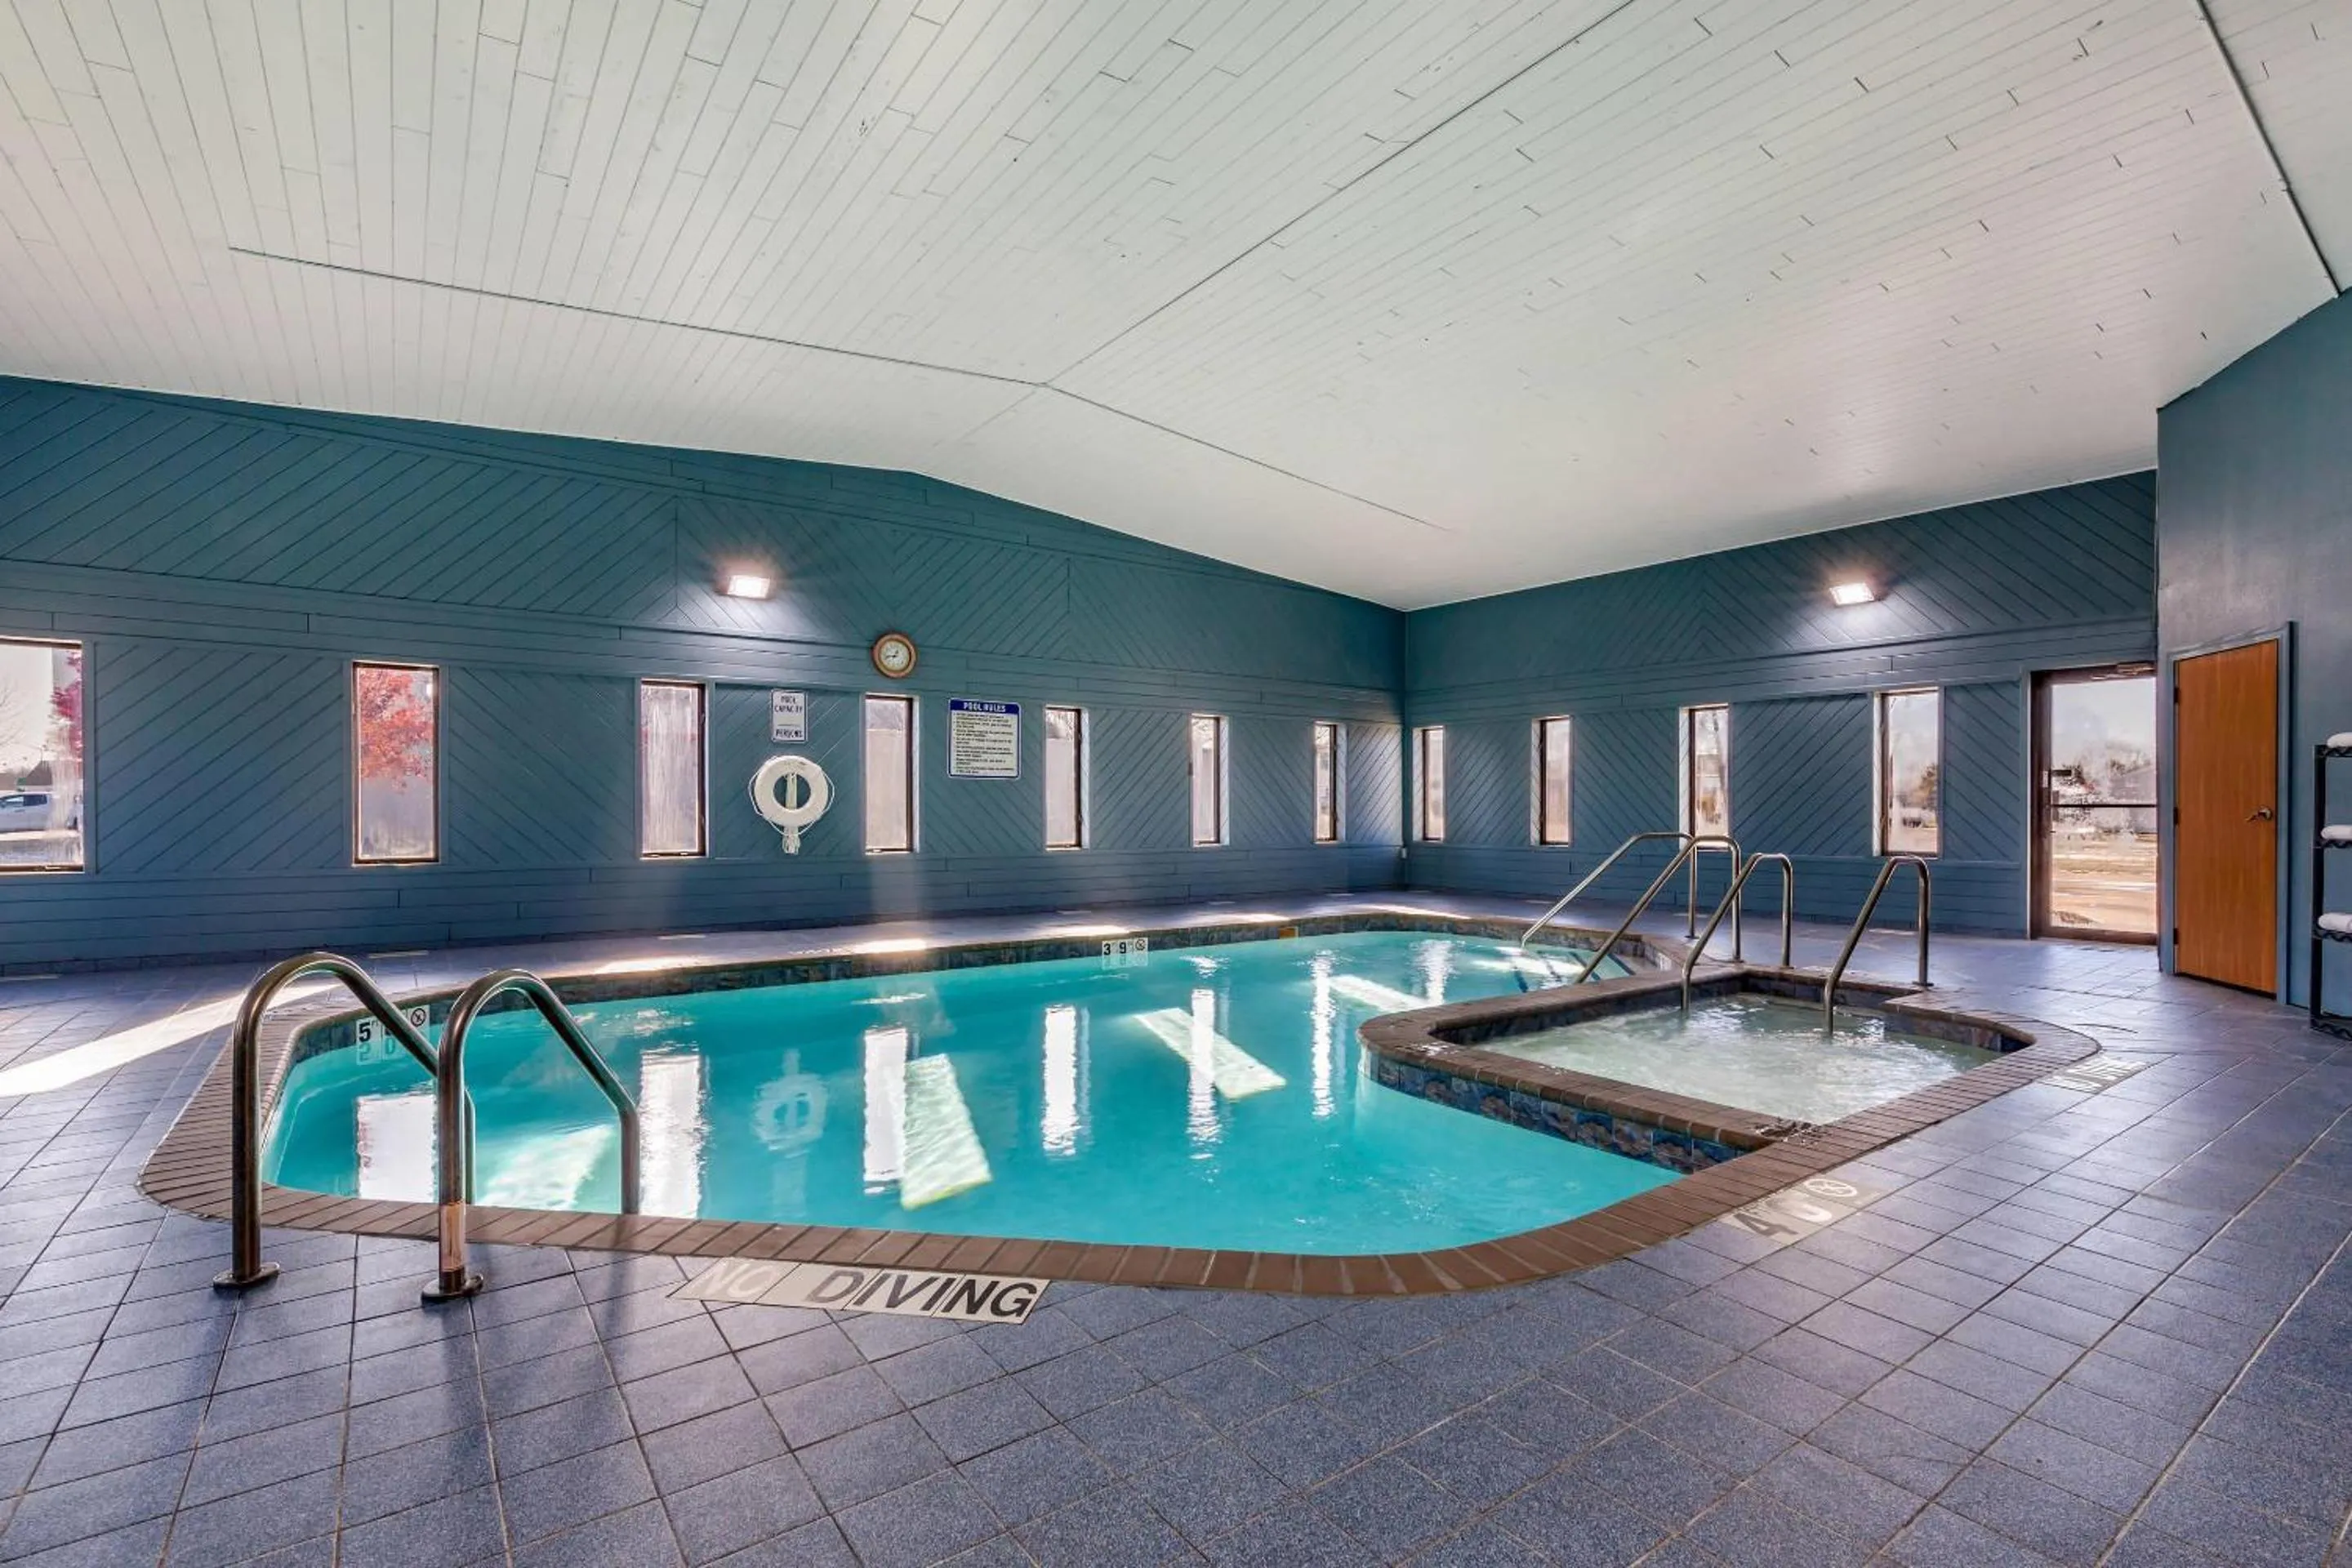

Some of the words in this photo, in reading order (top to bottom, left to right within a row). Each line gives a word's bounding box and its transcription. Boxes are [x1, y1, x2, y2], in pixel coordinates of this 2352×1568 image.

[964, 702, 982, 711] POOL
[983, 703, 1006, 713] RULES
[1103, 942, 1111, 956] 3
[1119, 942, 1127, 955] 9
[359, 1022, 371, 1042] 5
[684, 1258, 779, 1298] NO
[805, 1269, 1038, 1317] DIVING
